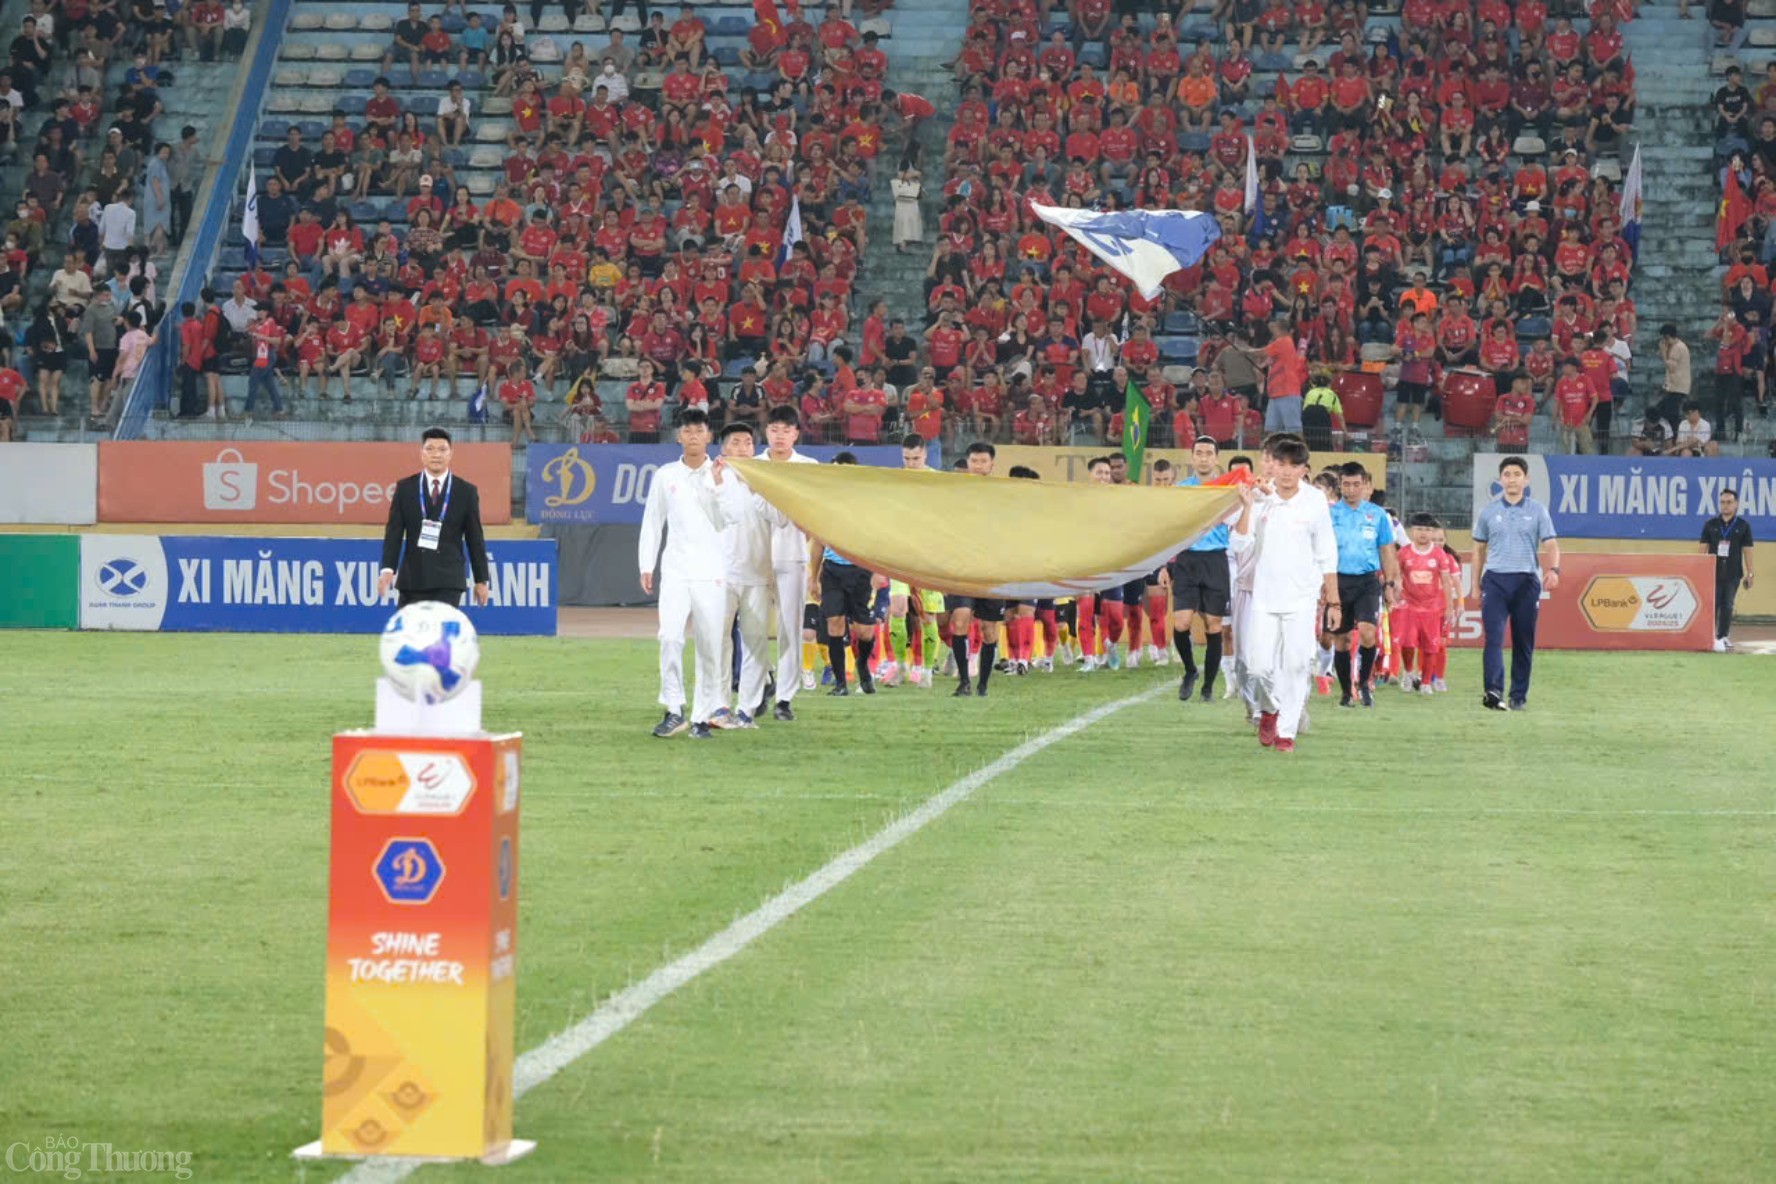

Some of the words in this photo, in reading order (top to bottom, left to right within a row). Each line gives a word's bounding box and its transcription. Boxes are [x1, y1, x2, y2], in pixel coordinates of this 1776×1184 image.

[1558, 473, 1588, 514] XI
[1598, 466, 1688, 516] MĂNG
[177, 558, 211, 603] XI
[222, 549, 325, 606] MĂNG
[1590, 597, 1629, 608] LPBank
[370, 931, 442, 957] SHINE
[346, 956, 465, 987] TOGETHER
